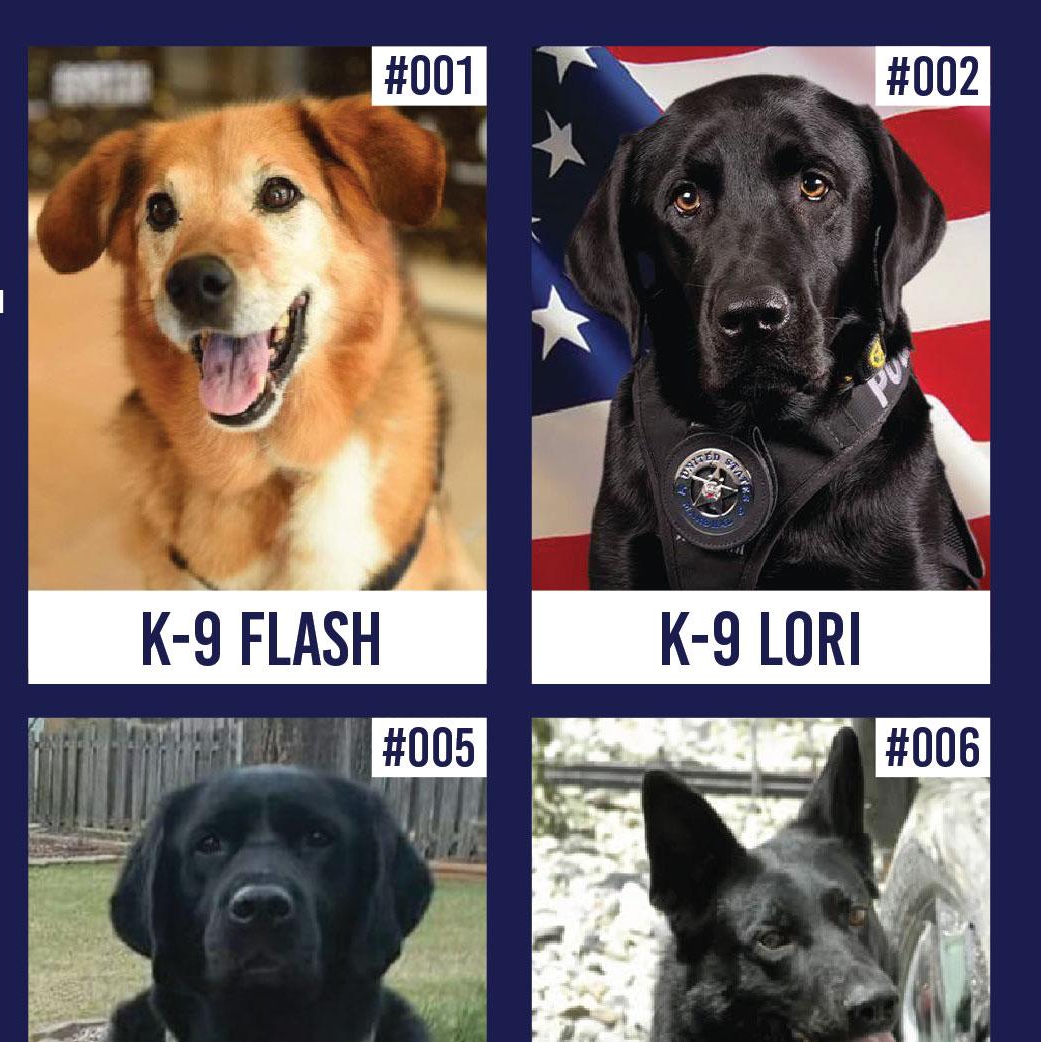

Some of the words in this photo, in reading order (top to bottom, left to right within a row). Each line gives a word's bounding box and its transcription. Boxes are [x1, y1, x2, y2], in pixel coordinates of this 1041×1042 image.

[385, 55, 472, 95] #001
[887, 56, 979, 96] #002
[143, 611, 220, 666] K-9
[242, 611, 379, 666] FLASH
[662, 611, 739, 666] K-9
[761, 611, 860, 666] LORI
[383, 727, 475, 767] #005
[886, 727, 979, 767] #006
